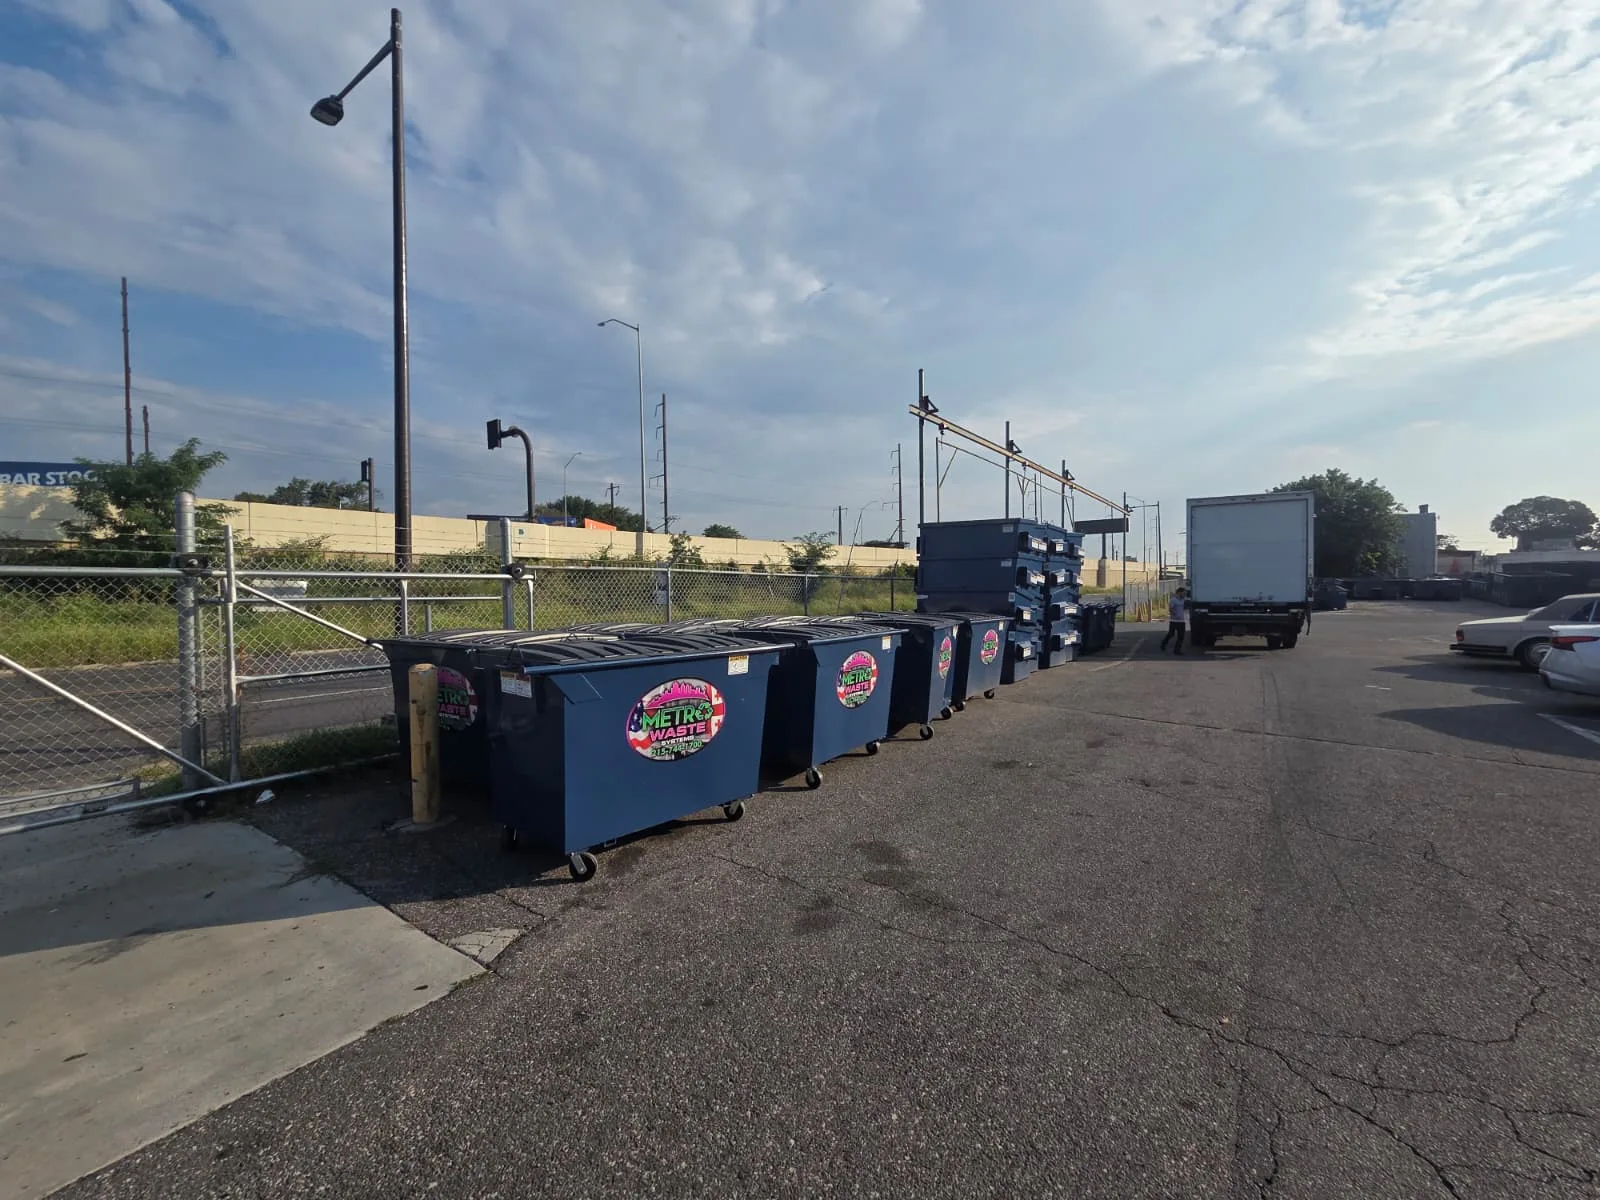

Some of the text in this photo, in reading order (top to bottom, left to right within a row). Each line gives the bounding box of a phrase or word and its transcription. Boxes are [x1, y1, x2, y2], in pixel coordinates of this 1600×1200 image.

[437, 687, 470, 706] ETRO
[439, 704, 467, 717] ASTE
[642, 702, 714, 732] METRO
[649, 722, 706, 743] WASTE
